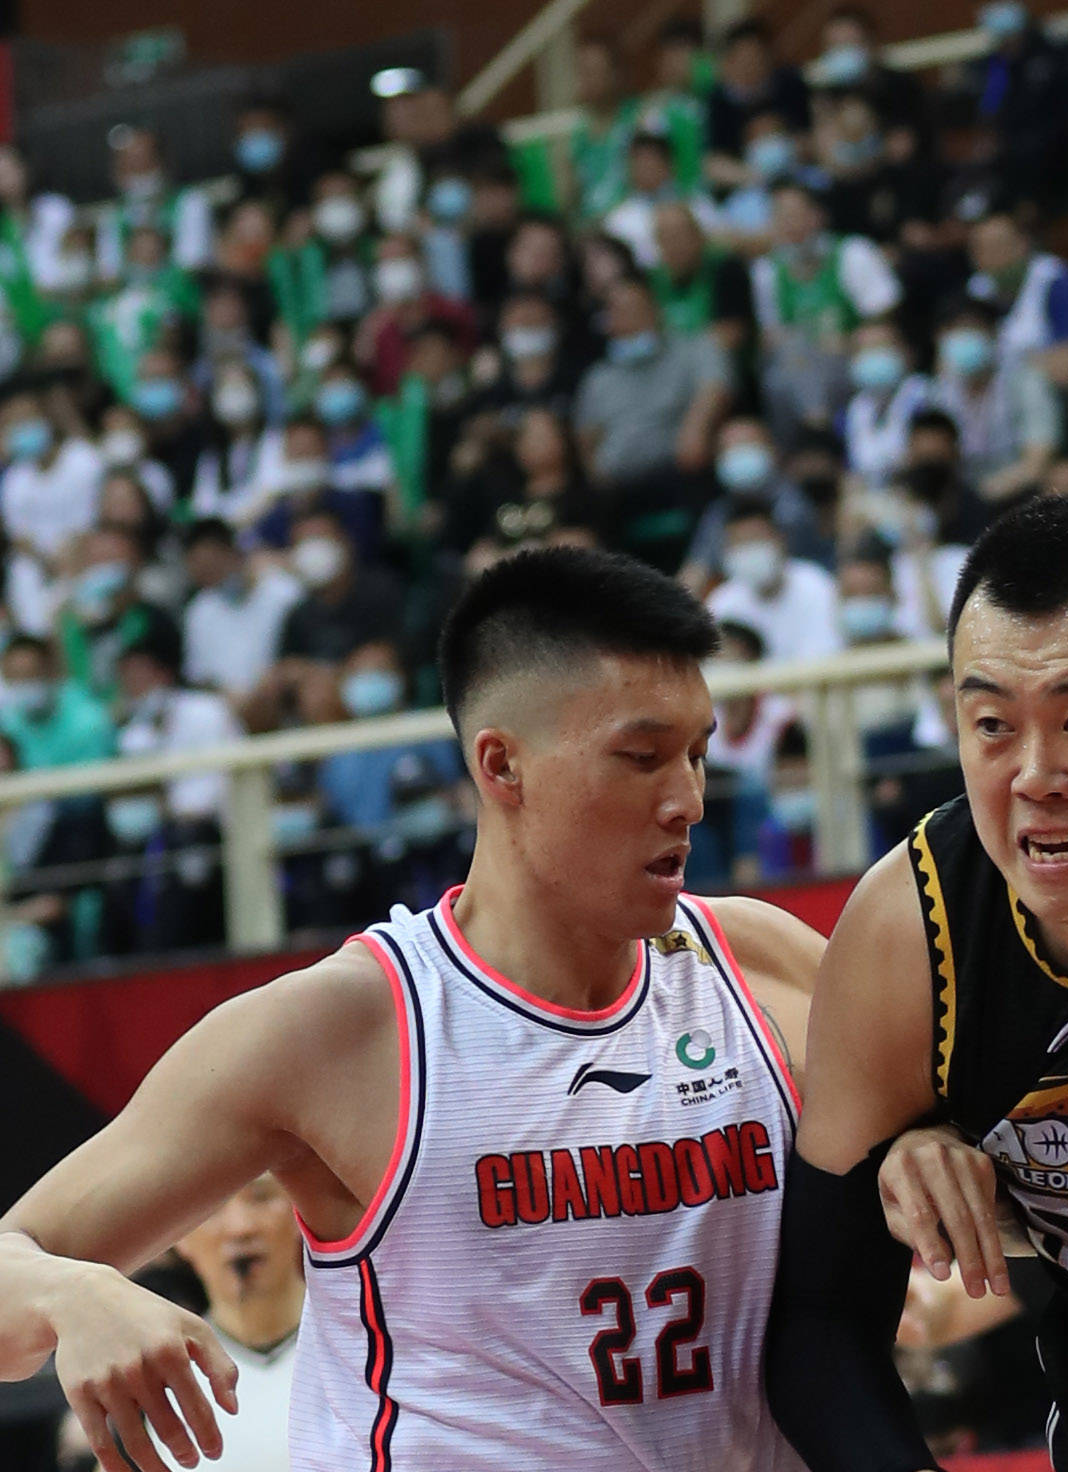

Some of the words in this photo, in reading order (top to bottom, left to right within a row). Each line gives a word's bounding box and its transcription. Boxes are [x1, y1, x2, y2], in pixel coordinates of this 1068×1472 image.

[681, 1093, 716, 1106] CHINA
[719, 1080, 743, 1094] LIFE
[475, 1120, 779, 1228] GUANGDONG
[579, 1266, 714, 1407] 22
